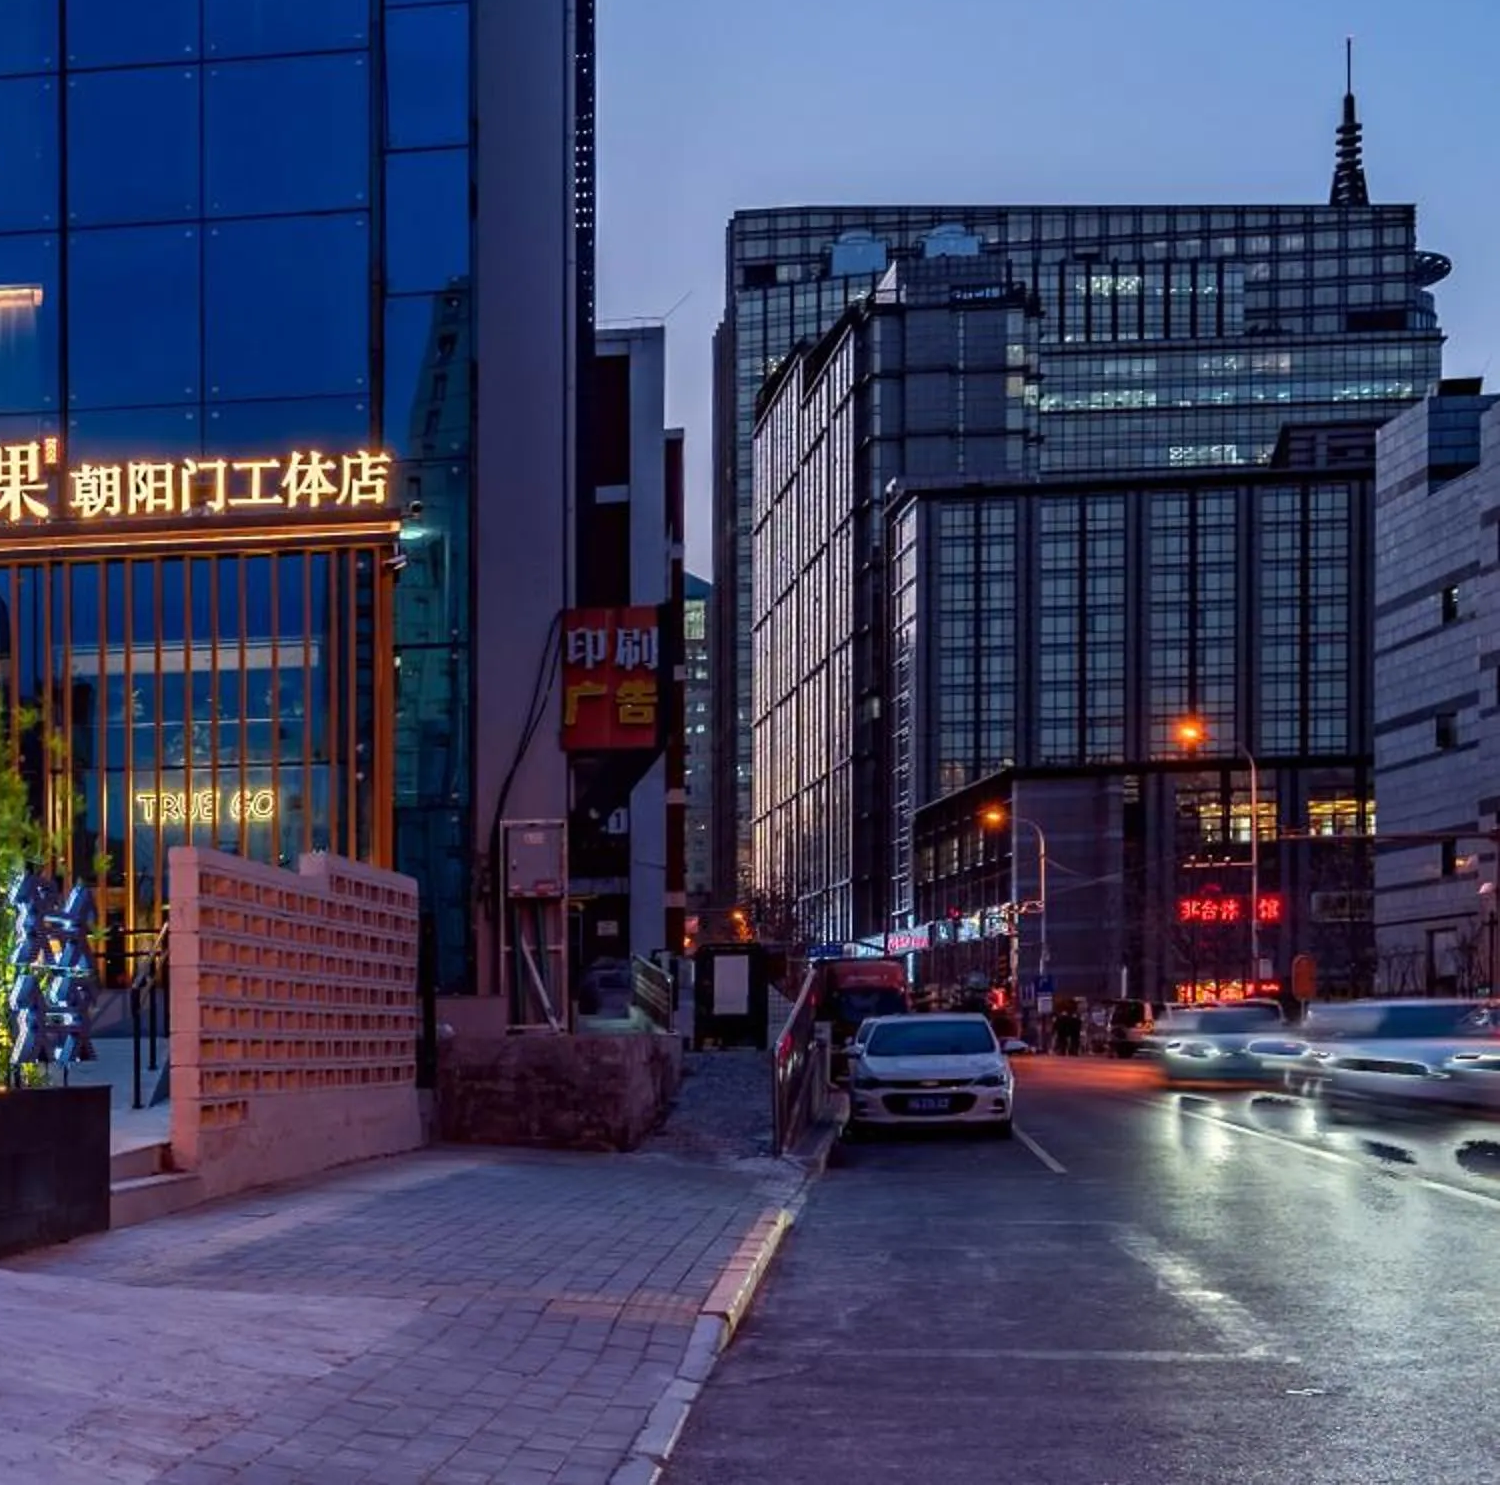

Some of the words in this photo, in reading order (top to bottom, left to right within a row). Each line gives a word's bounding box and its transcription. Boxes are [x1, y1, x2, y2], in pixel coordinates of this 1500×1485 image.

[68, 449, 392, 516] 朝阳门工体店
[566, 625, 659, 670] 印刷
[564, 679, 659, 727] 广告
[135, 788, 221, 825] TRUE
